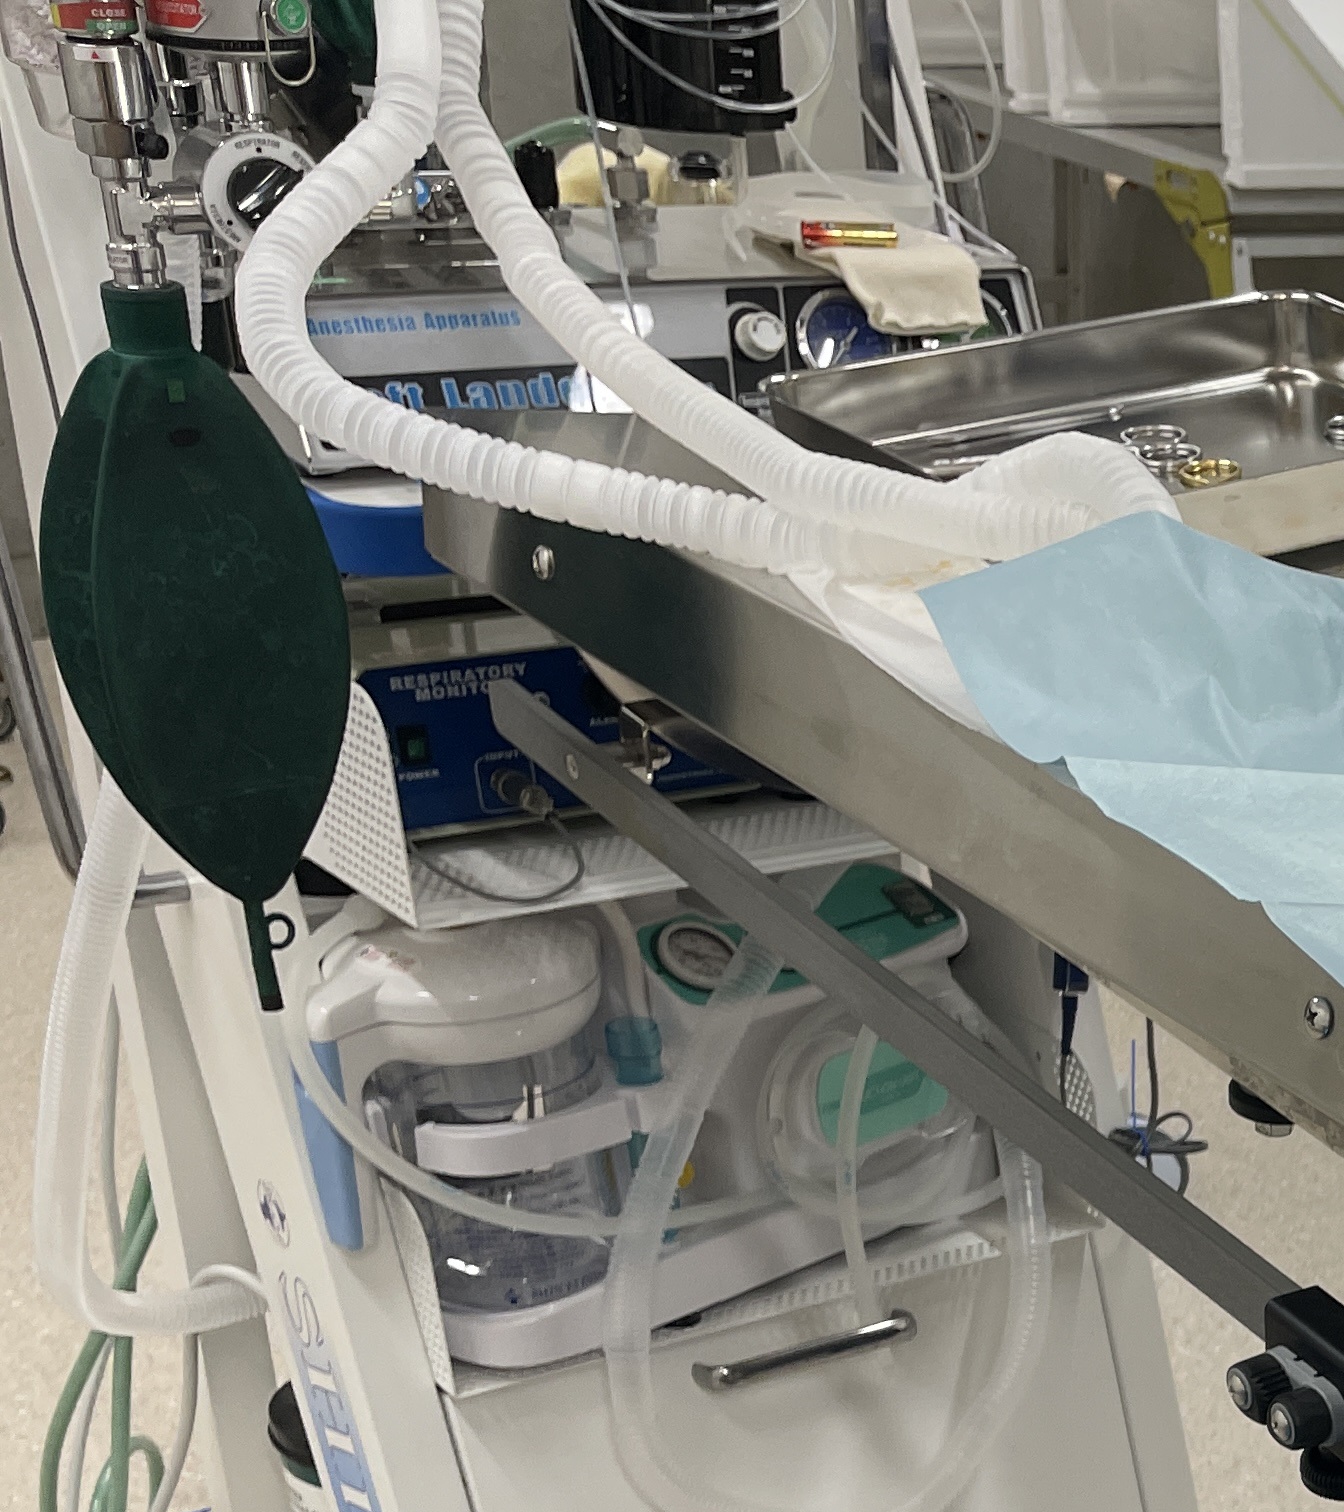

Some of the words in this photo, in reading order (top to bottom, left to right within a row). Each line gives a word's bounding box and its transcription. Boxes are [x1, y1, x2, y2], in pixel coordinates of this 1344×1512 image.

[307, 310, 416, 336] Anesthesia
[423, 304, 521, 330] Apparatus
[389, 661, 526, 692] RESPIRATORY
